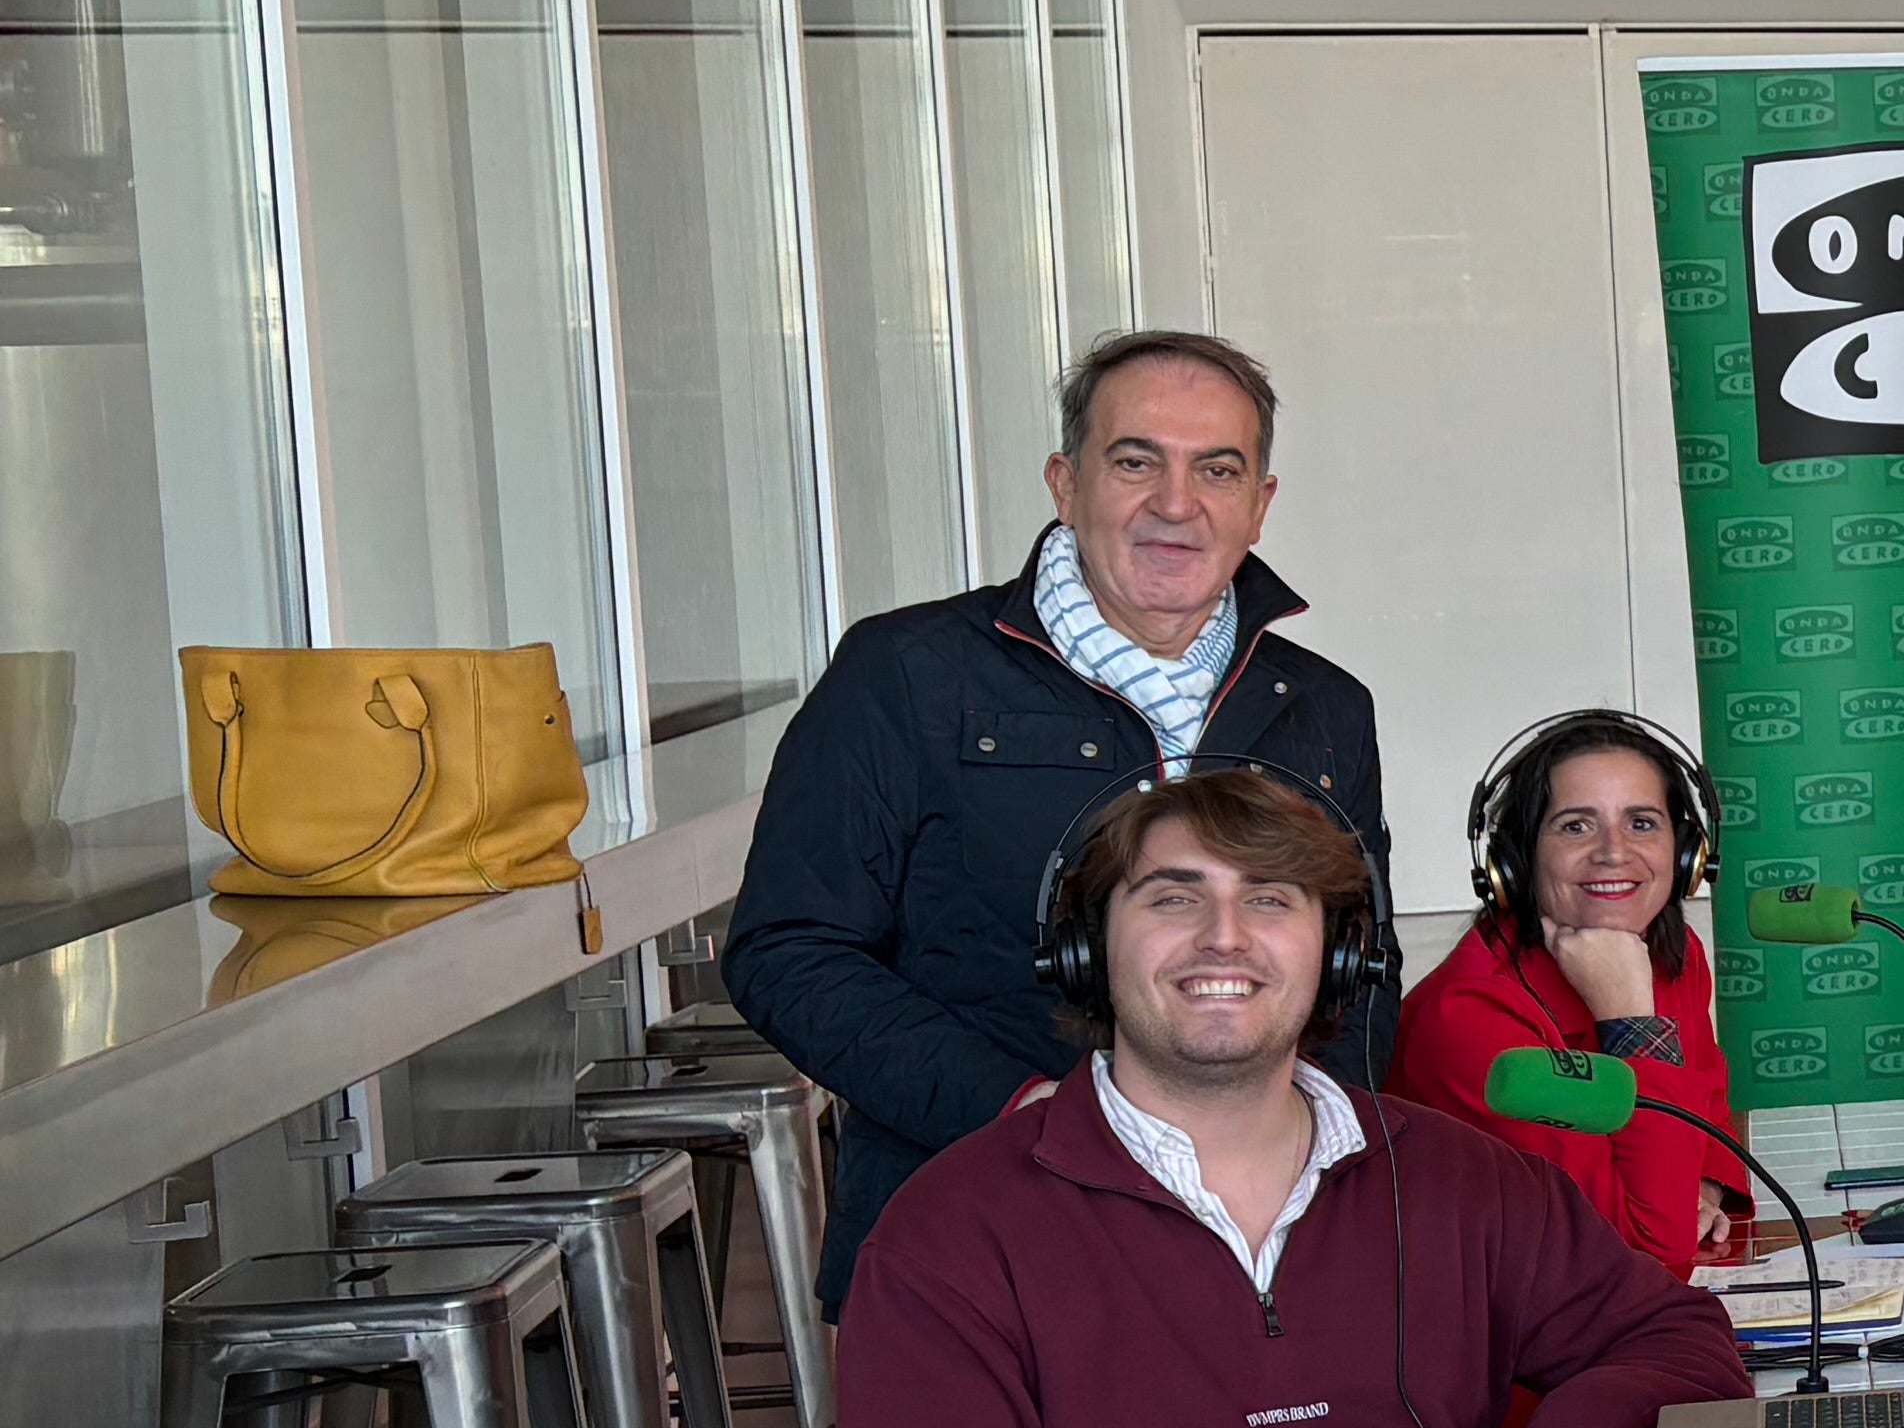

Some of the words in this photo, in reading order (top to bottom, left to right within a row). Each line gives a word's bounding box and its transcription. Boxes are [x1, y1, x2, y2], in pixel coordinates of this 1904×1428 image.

[1650, 89, 1706, 102] ONDA
[1766, 86, 1824, 98] ONDA
[1655, 111, 1708, 127] CERO
[1771, 108, 1825, 123] CERO
[1783, 464, 1835, 477] CERO
[1726, 528, 1781, 540] ONDA
[1842, 524, 1898, 537] ONDA
[1732, 550, 1783, 564] CERO
[1847, 546, 1900, 560] CERO
[1785, 616, 1842, 630] ONDA
[1790, 638, 1844, 652] CERO
[1736, 702, 1790, 714] ONDA
[1850, 698, 1904, 710] ONDA
[1740, 724, 1792, 737] CERO
[1804, 782, 1862, 796] ONDA
[1810, 804, 1862, 818] CERO
[1754, 868, 1809, 880] ONDA
[1812, 954, 1868, 966] ONDA
[1816, 974, 1870, 990] CERO
[1761, 1038, 1816, 1050] ONDA
[1765, 1060, 1817, 1074] CERO
[1290, 1401, 1329, 1421] BRAND
